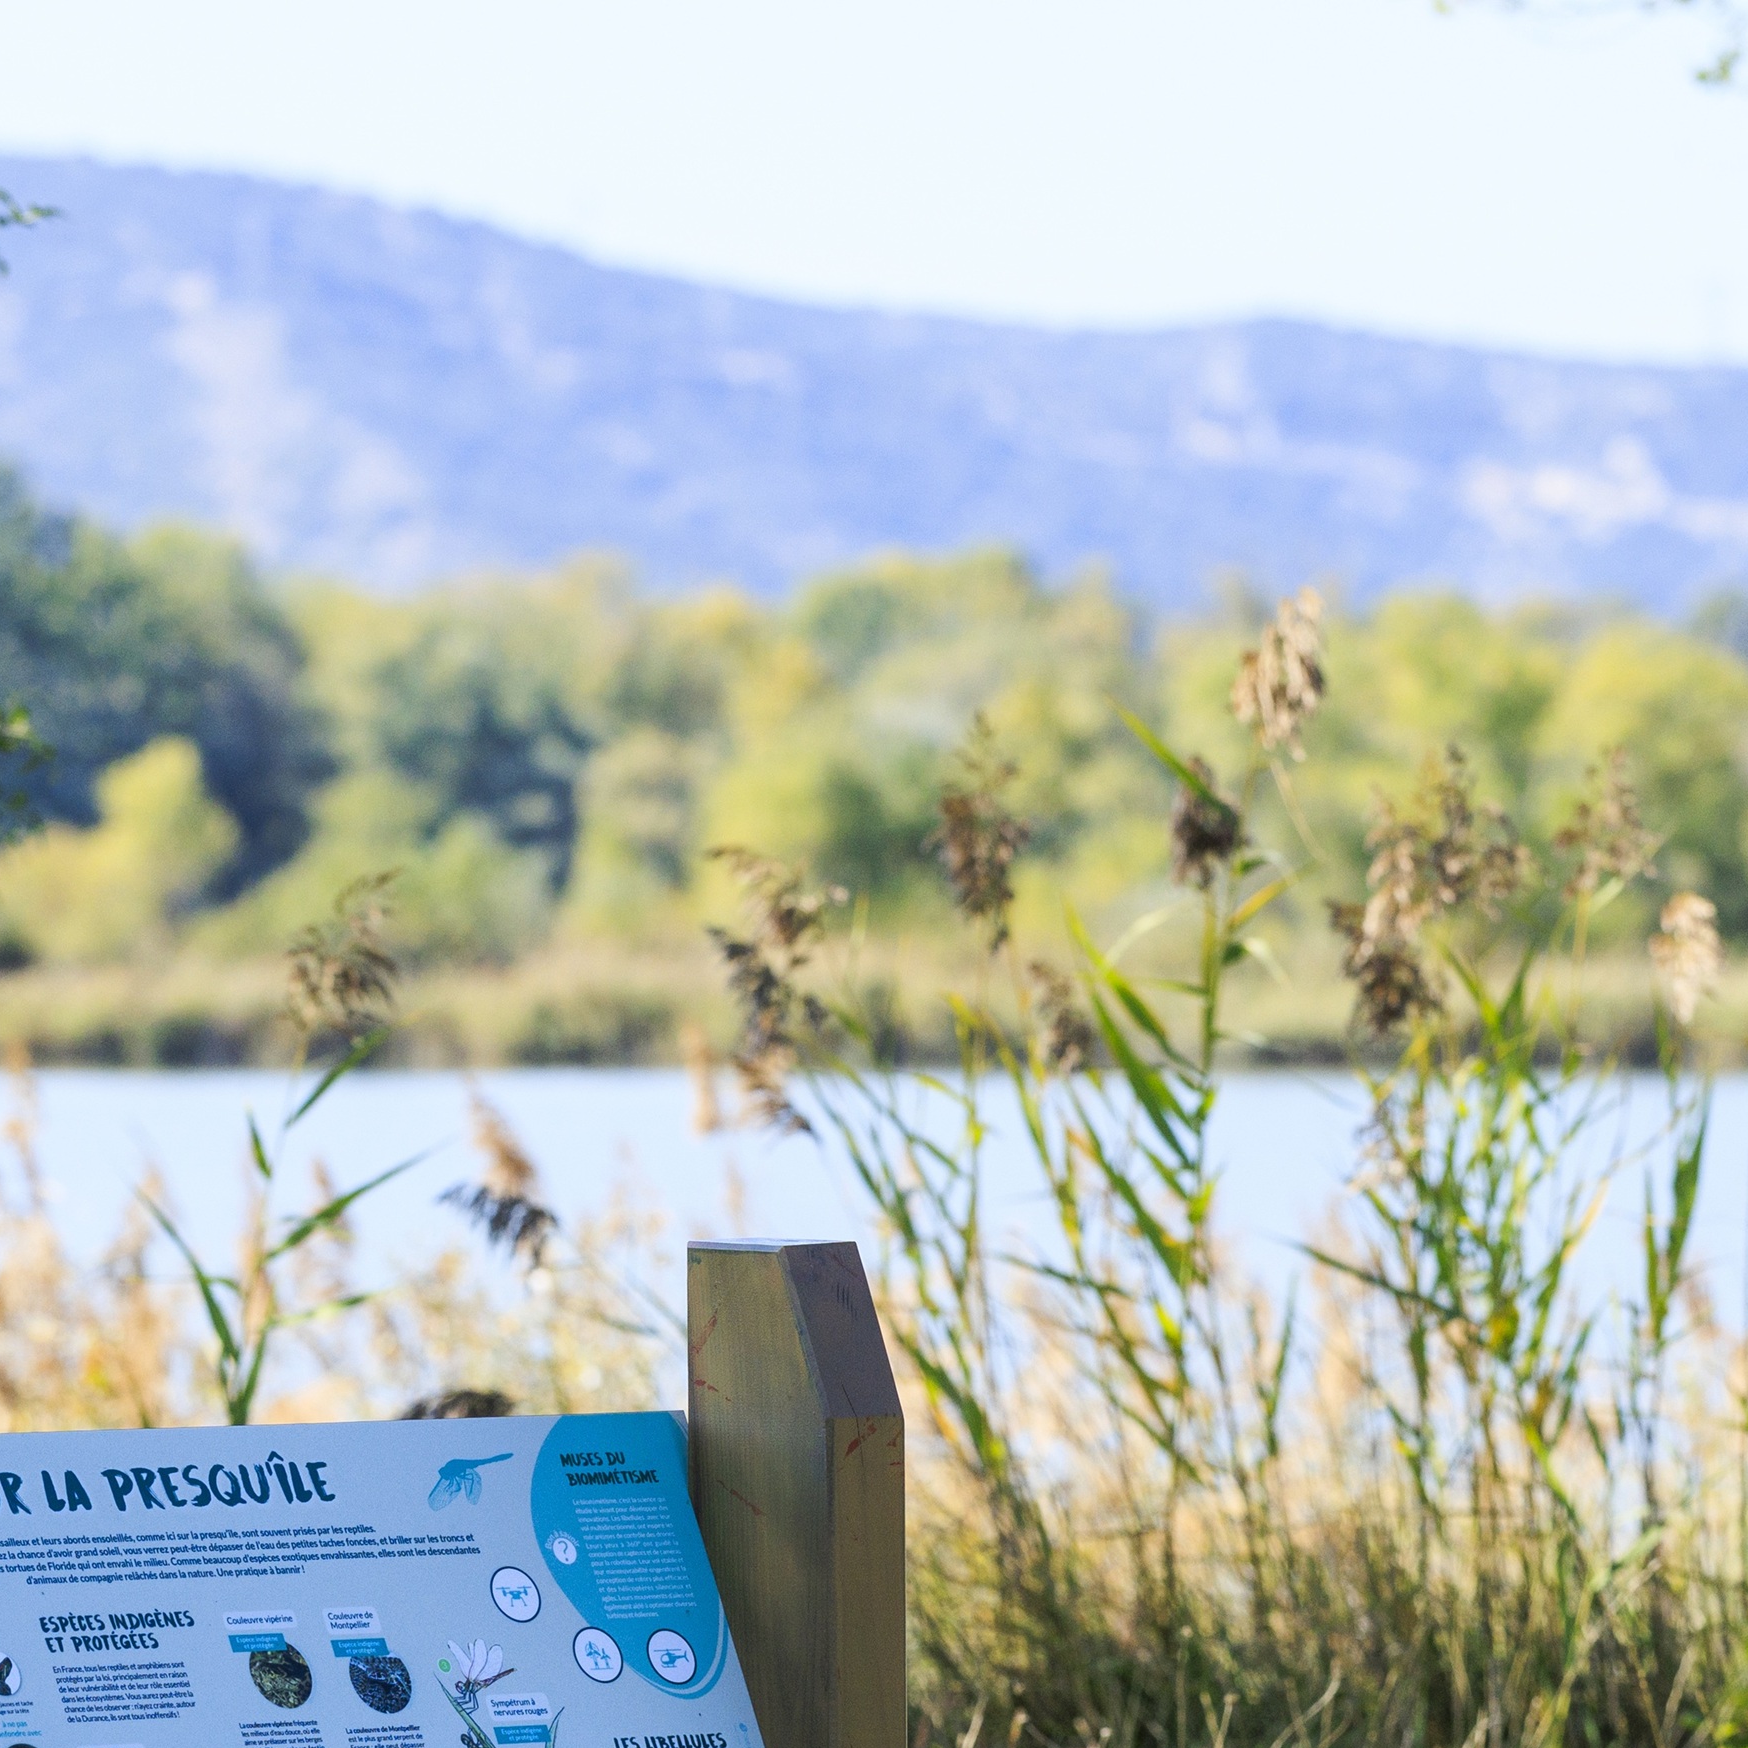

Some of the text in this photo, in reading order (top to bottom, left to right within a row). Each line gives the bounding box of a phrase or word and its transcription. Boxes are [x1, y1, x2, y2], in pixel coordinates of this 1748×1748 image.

[559, 1451, 625, 1466] MUSES DU
[41, 1470, 91, 1511] LA
[101, 1451, 336, 1511] PRESQU'ÎLE
[566, 1468, 658, 1485] BIOMIMÉTISME
[31, 1537, 40, 1545] et
[40, 1536, 61, 1545] leurs
[62, 1535, 90, 1544] abords
[91, 1533, 135, 1543] ensoleillés,
[165, 1531, 176, 1540] ici
[189, 1530, 199, 1539] la
[199, 1529, 241, 1540] presqu'île,
[241, 1529, 259, 1537] sont
[259, 1528, 291, 1536] souvent
[292, 1526, 316, 1537] prisés
[316, 1527, 330, 1536] par
[330, 1525, 343, 1534] les
[343, 1524, 375, 1534] reptiles.
[4, 1564, 35, 1572] tortues
[35, 1562, 47, 1571] de
[47, 1561, 76, 1570] Floride
[77, 1560, 90, 1571] qui
[91, 1560, 105, 1568] ont
[106, 1558, 133, 1568] envahi
[133, 1558, 142, 1567] le
[143, 1557, 169, 1566] milieu.
[170, 1556, 201, 1565] Comme
[201, 1556, 241, 1564] beaucoup
[242, 1553, 280, 1563] d'espèces
[281, 1552, 319, 1562] exotiques
[320, 1550, 377, 1559] envahissantes,
[377, 1548, 396, 1557] elles
[396, 1548, 414, 1557] sont
[414, 1547, 427, 1556] les
[427, 1546, 480, 1555] descendantes
[26, 1565, 300, 1584] d'animaux de compagnie relâchés dans la nature. Une pratique à bannir
[39, 1609, 194, 1632] ESPÈCES INDIGÈNES
[226, 1614, 292, 1624] Couleuvre vipérine
[327, 1612, 363, 1620] Couleuvre
[329, 1620, 369, 1629] Montpellier
[44, 1630, 158, 1652] ET PROTÉGÉES
[52, 1665, 61, 1673] En
[106, 1663, 129, 1671] reptiles
[137, 1661, 171, 1670] amphibiens
[490, 1697, 535, 1707] Sympétrum à
[524, 1708, 548, 1716] rouges
